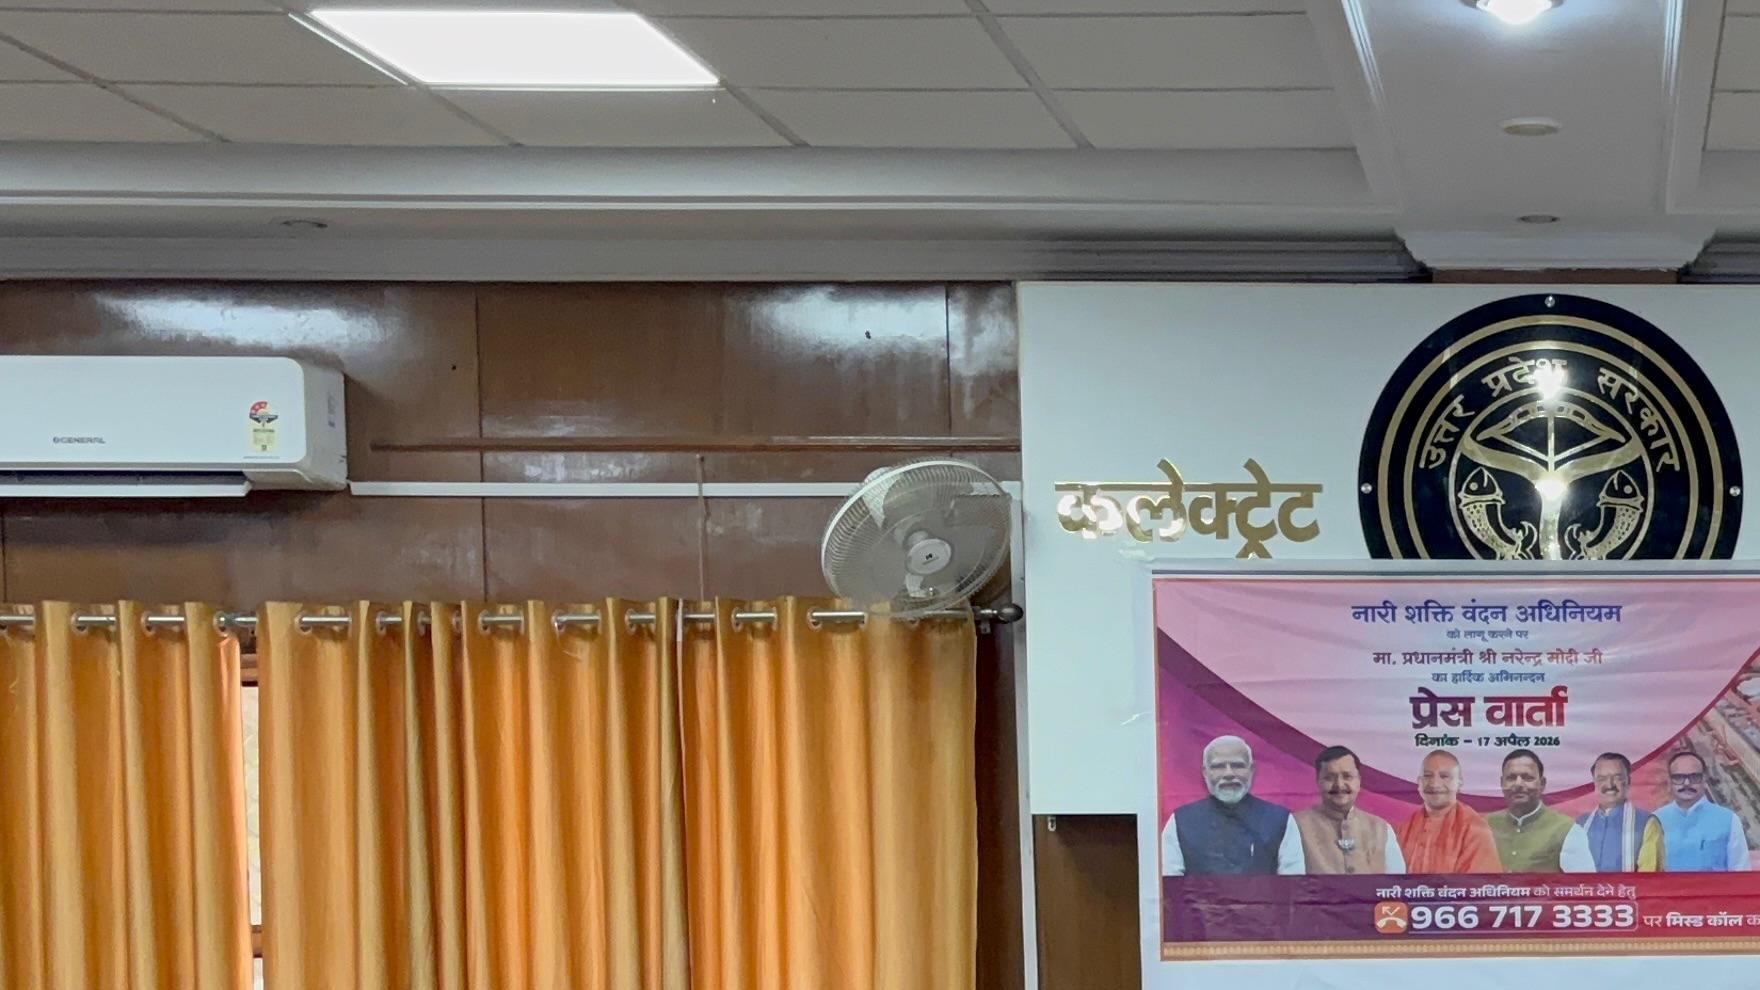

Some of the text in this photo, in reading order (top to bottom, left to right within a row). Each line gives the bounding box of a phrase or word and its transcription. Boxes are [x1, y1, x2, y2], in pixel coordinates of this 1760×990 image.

[1419, 394, 1475, 469] उत्तर
[1597, 367, 1680, 472] सरकार
[1054, 457, 1323, 560] कलेक्ट्रेट
[1351, 599, 1622, 624] नारी शक्ति वंदन अधिनियम
[1446, 628, 1461, 639] को
[1515, 630, 1529, 640] पर
[1373, 647, 1602, 667] मा. प्रधानमंत्री श्री नरेन्द्र मोदी जी
[1431, 672, 1448, 683] का
[1409, 685, 1569, 730] प्रेस वार्ता
[1414, 733, 1459, 747] दिनांक
[1477, 736, 1490, 747] 17
[1534, 736, 1561, 747] 2026
[1376, 883, 1637, 900] नारी शक्ति वंदन अधिनियम को समर्थन देने हेतु
[1410, 905, 1479, 929] 966
[1488, 905, 1543, 928] 717
[1552, 904, 1634, 928] 3333
[1642, 915, 1663, 927] पर
[1666, 911, 1704, 928] मिस्ड
[1706, 911, 1743, 927] कॉल
